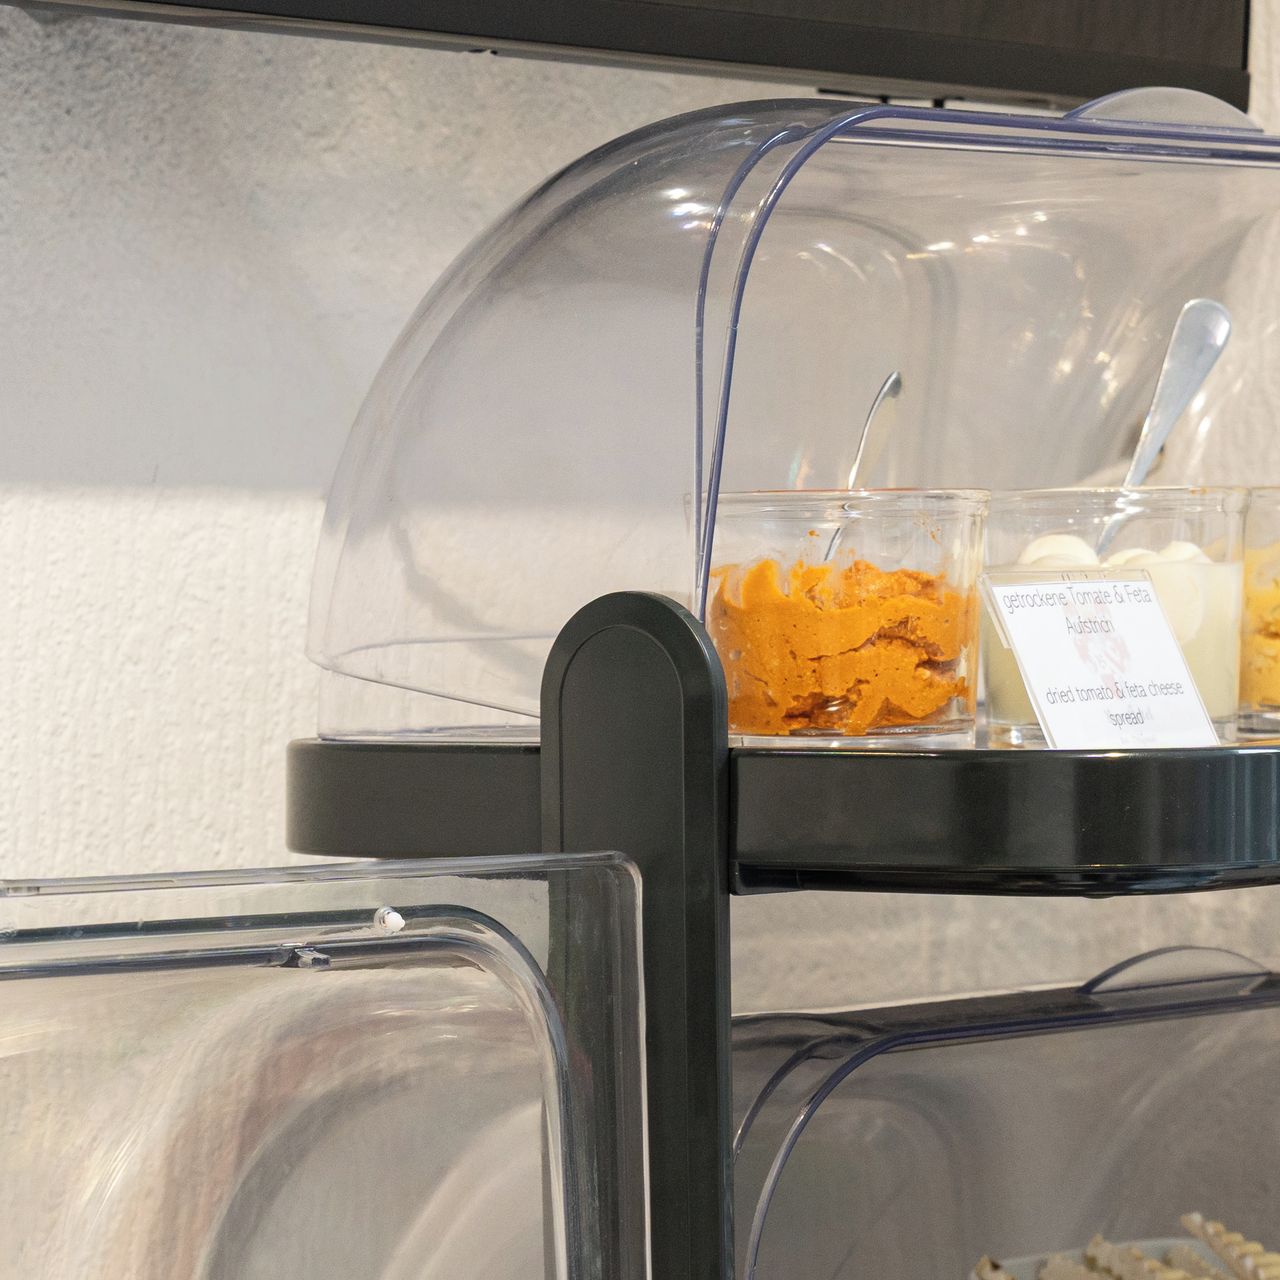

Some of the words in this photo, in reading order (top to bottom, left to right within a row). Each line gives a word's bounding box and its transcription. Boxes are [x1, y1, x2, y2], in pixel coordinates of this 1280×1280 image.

[1002, 588, 1068, 615] getrockene
[1066, 586, 1112, 605] Tomate
[1113, 585, 1125, 603] &
[1125, 584, 1153, 603] Feta
[1065, 616, 1114, 635] Aufstrich
[1046, 684, 1074, 705] dried
[1076, 685, 1113, 702] tomato
[1115, 682, 1126, 700] &
[1126, 680, 1147, 699] feta
[1149, 679, 1185, 697] cheese
[1109, 707, 1145, 731] spread
